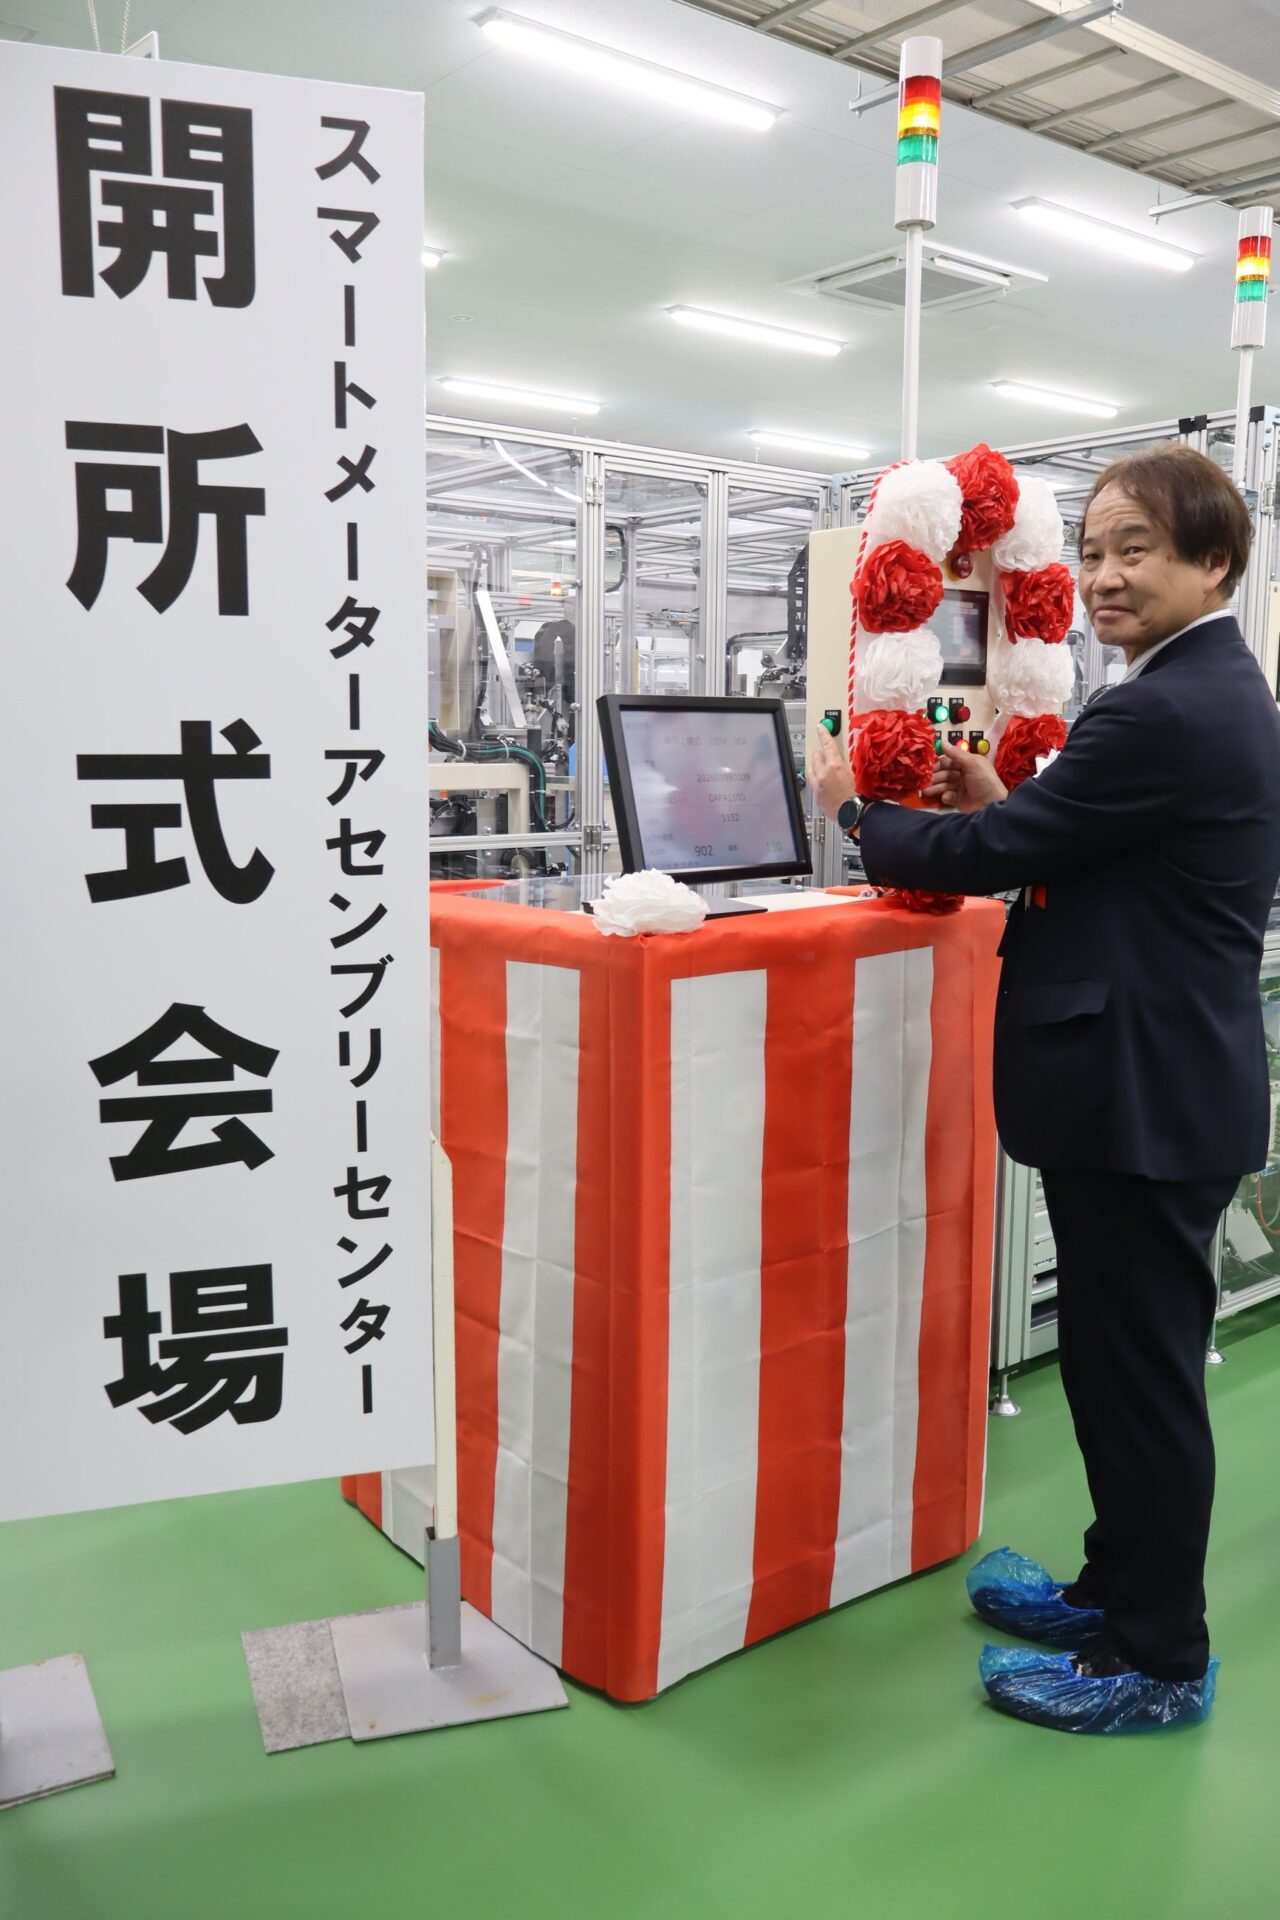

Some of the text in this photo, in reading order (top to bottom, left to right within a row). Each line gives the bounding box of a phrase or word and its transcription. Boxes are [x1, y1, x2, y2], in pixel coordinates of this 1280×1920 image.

[53, 85, 289, 1436] 開所式会場
[315, 116, 395, 1414] スマートメーターアセンブリーセンター
[694, 845, 714, 857] 902
